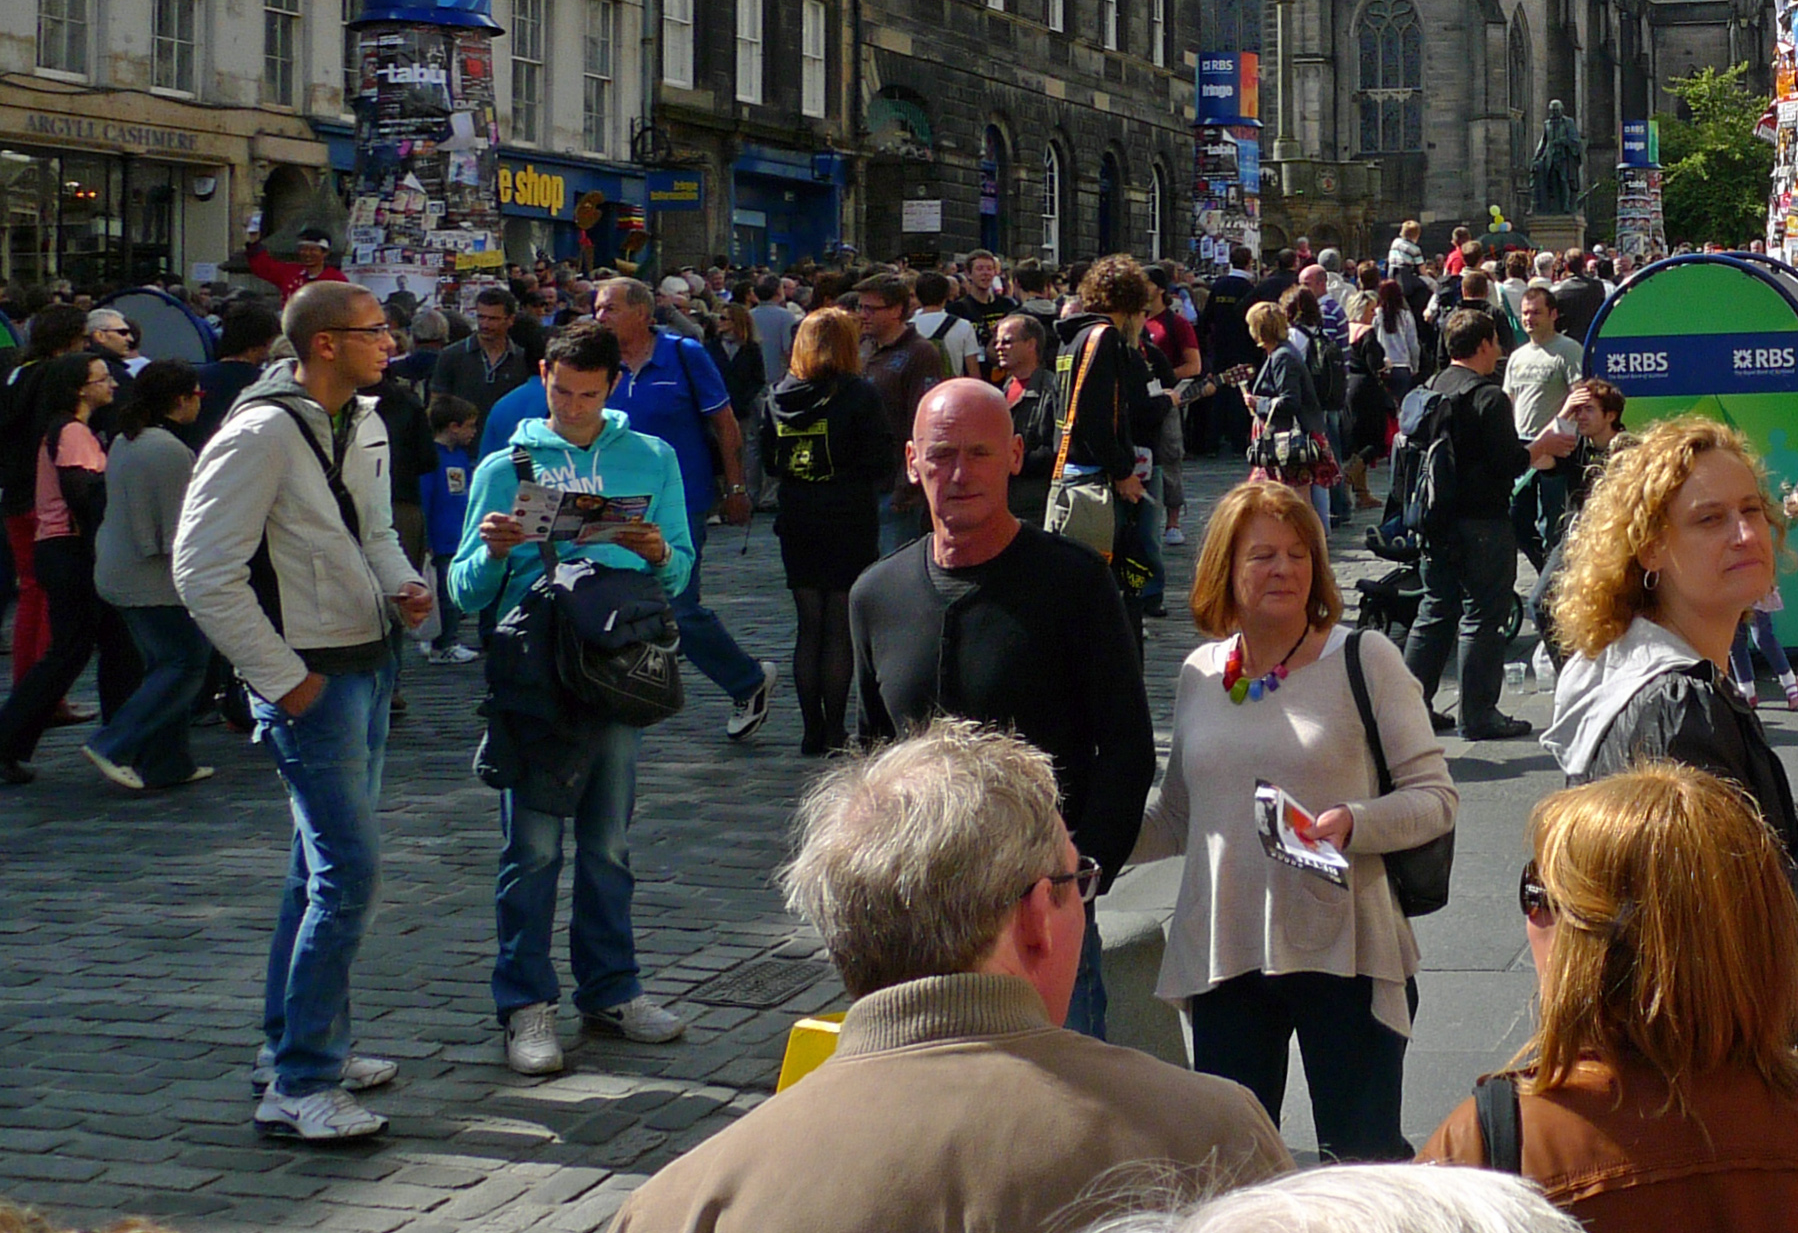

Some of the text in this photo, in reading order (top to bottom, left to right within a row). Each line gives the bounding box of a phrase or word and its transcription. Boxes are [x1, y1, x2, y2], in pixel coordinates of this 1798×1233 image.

[1211, 59, 1233, 71] RBS
[1202, 84, 1233, 98] fringe
[26, 114, 199, 151] ARGYLL CASHMERE
[515, 164, 565, 217] shop
[1629, 352, 1668, 372] RBS
[1755, 348, 1795, 368] RBS
